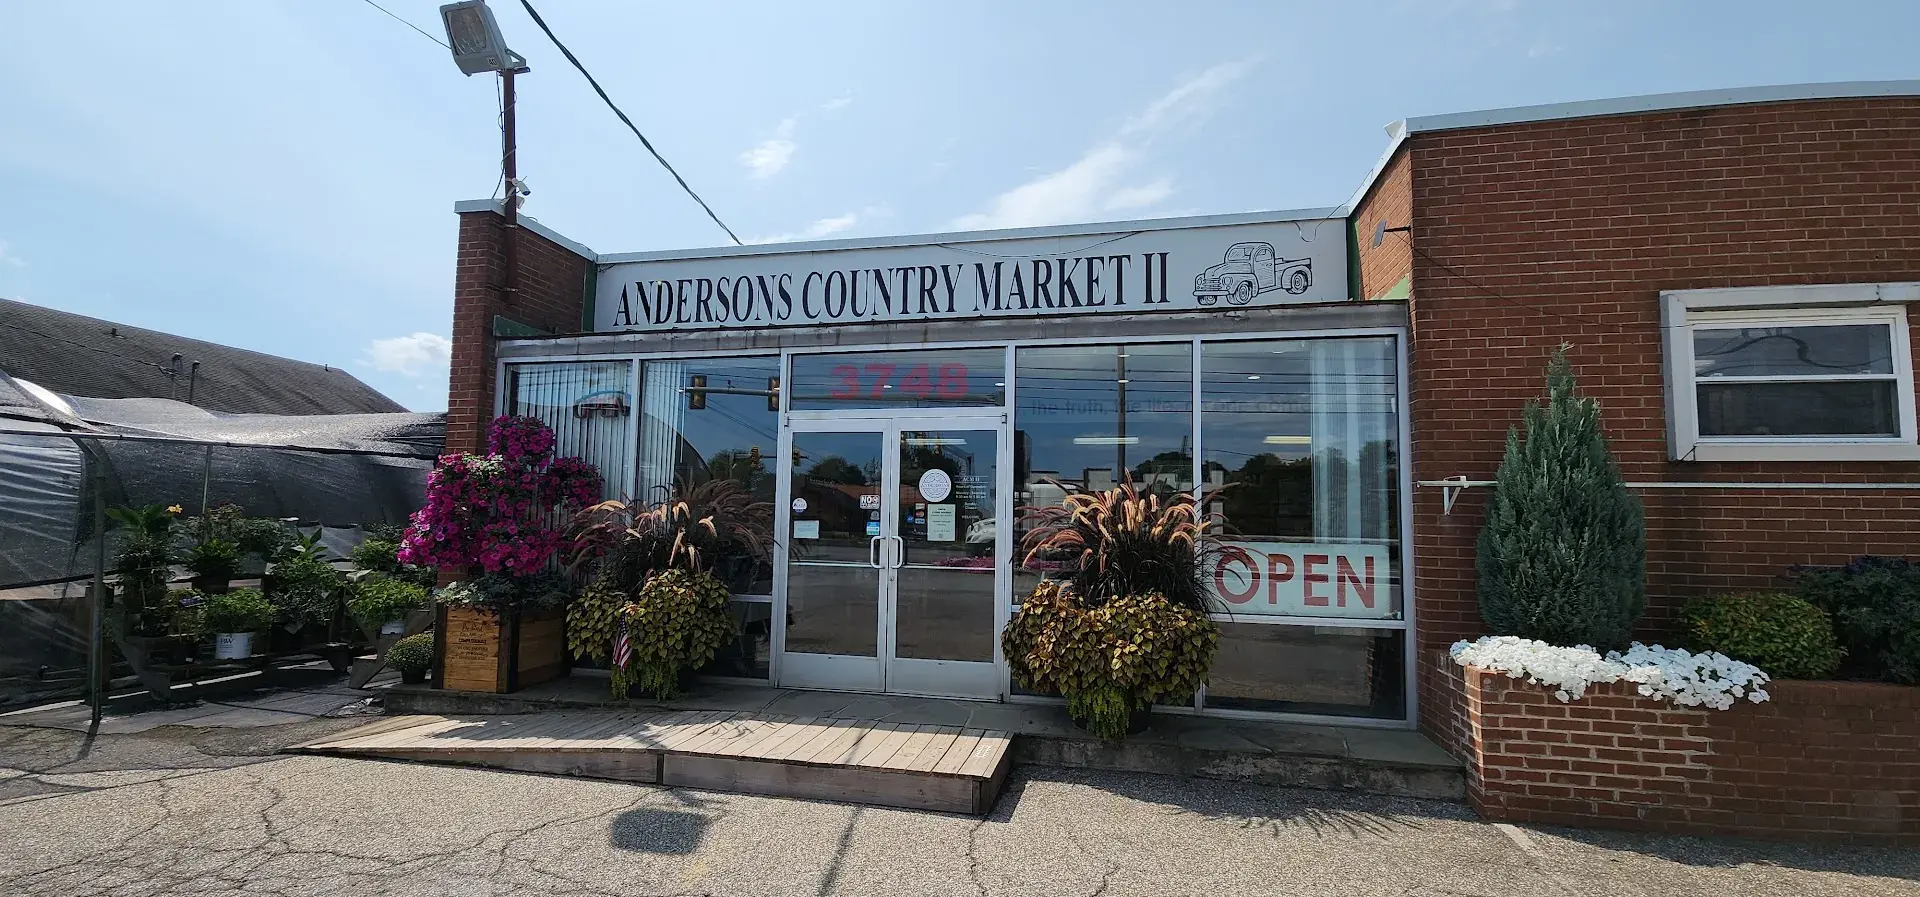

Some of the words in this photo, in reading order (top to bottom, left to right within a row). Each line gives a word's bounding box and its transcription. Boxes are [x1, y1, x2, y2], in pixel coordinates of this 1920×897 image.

[613, 272, 793, 327] ANDERSONS
[802, 262, 964, 319] COUNTRY
[973, 253, 1133, 313] MARKET
[1142, 251, 1170, 304] II
[831, 362, 969, 400] 3748
[1214, 545, 1376, 609] OPEN
